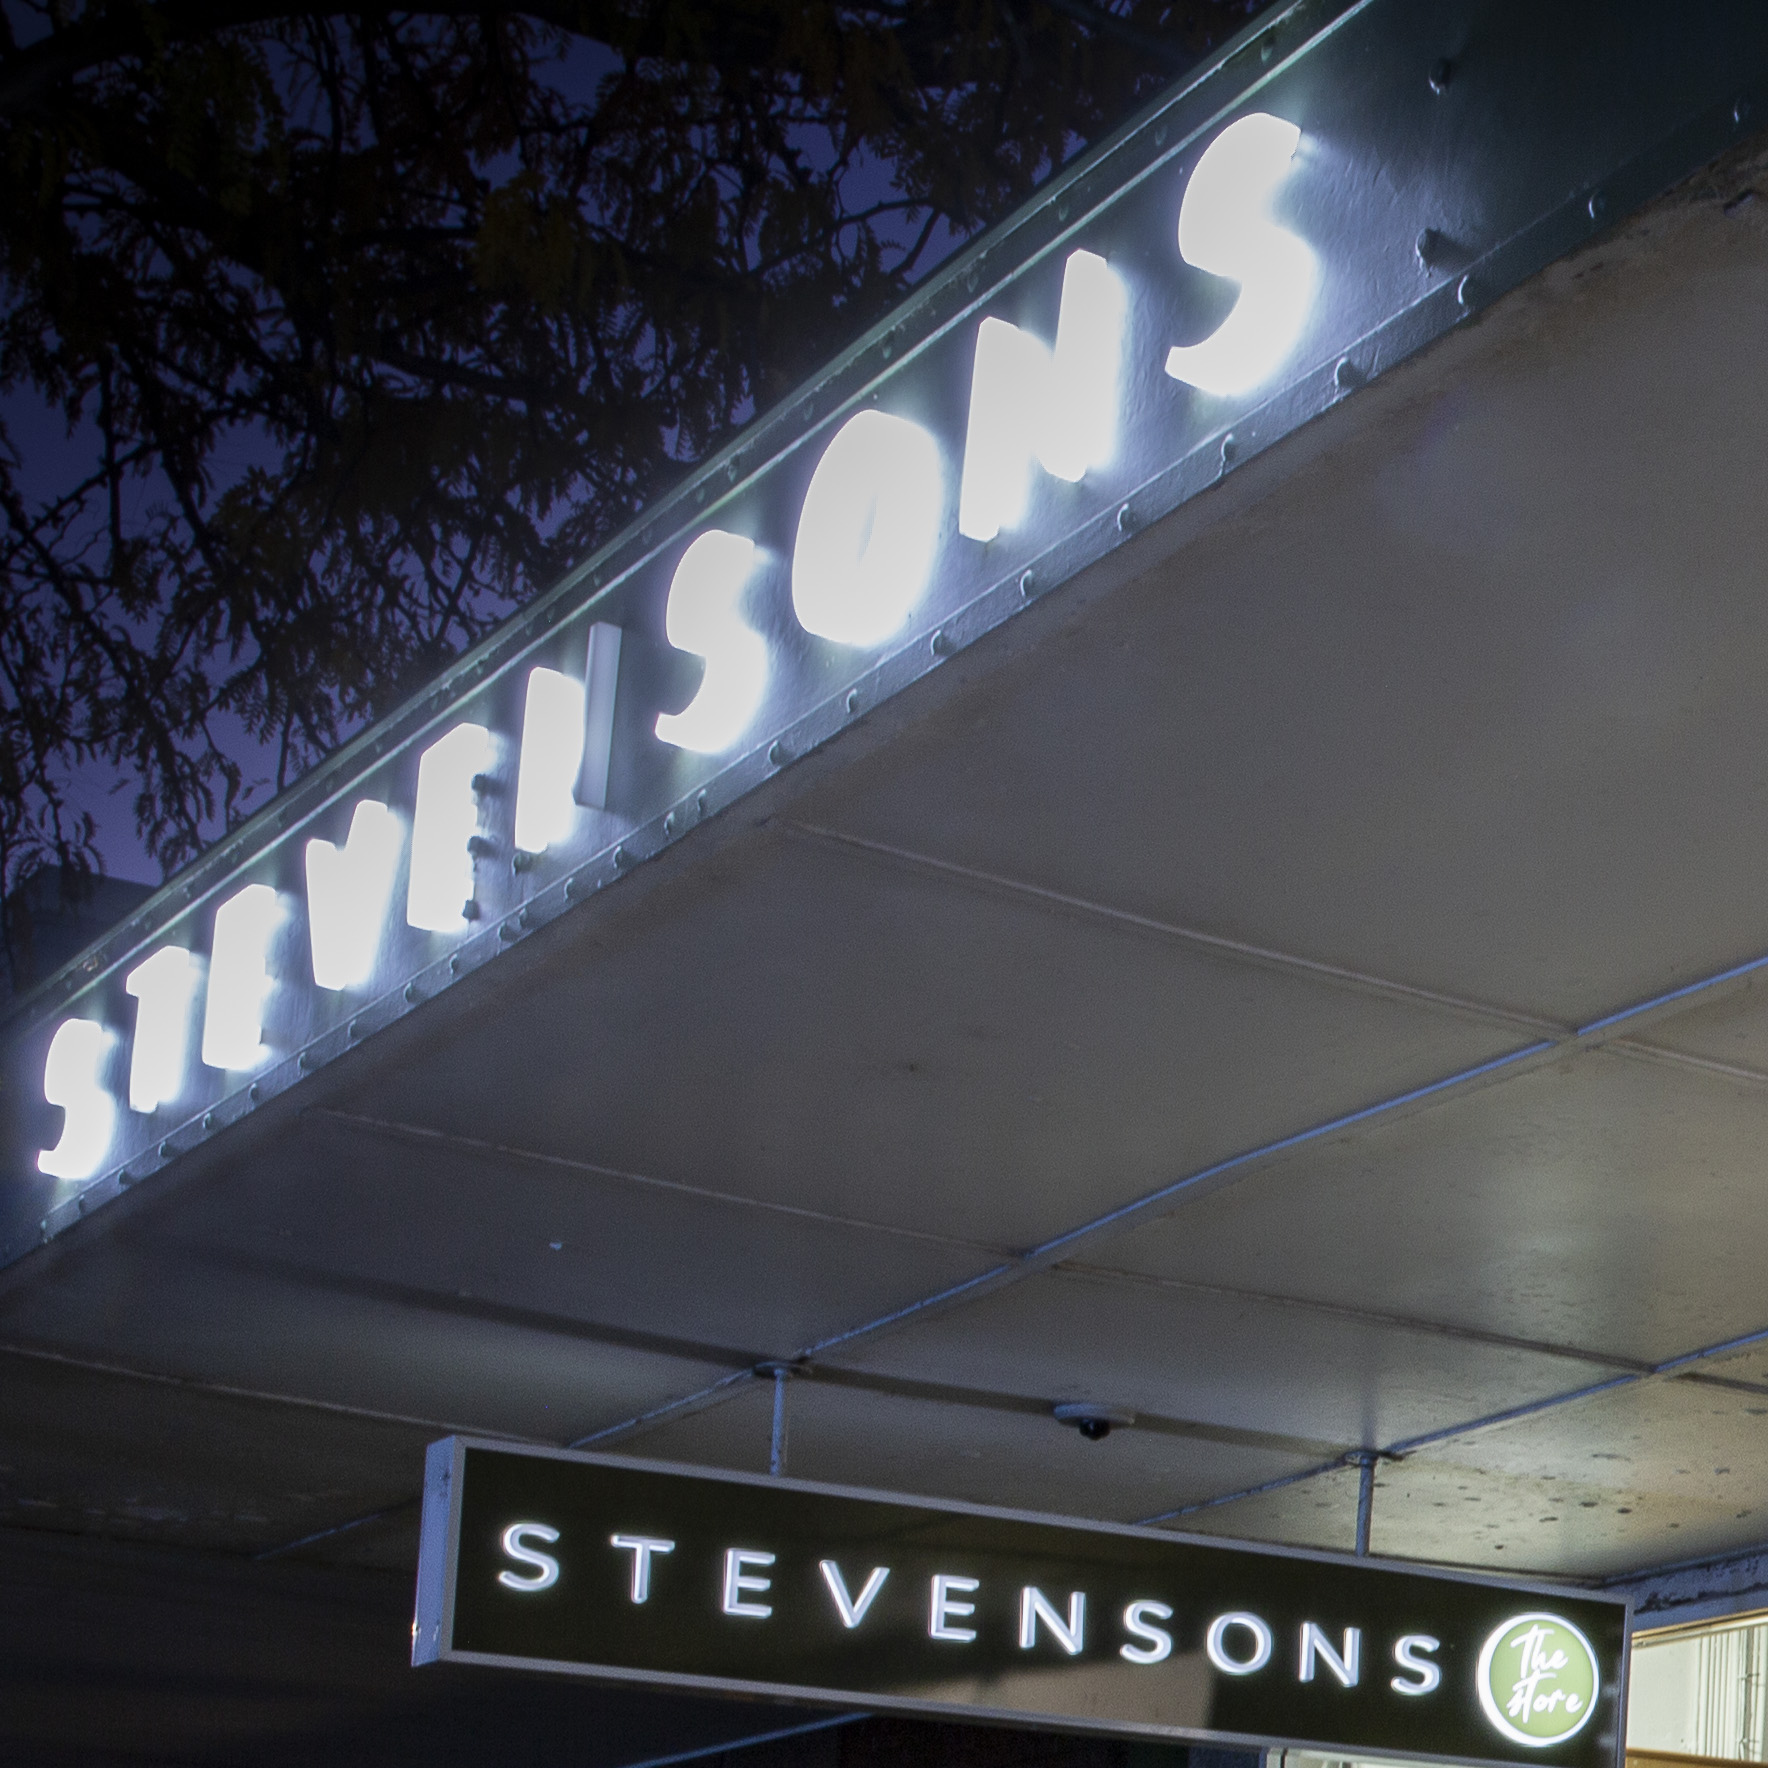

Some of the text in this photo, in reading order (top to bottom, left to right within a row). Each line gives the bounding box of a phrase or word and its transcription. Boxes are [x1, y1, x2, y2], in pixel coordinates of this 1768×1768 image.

[497, 1521, 1442, 1697] STEVENSONS
[1510, 1623, 1569, 1680] The
[1506, 1668, 1583, 1724] store
